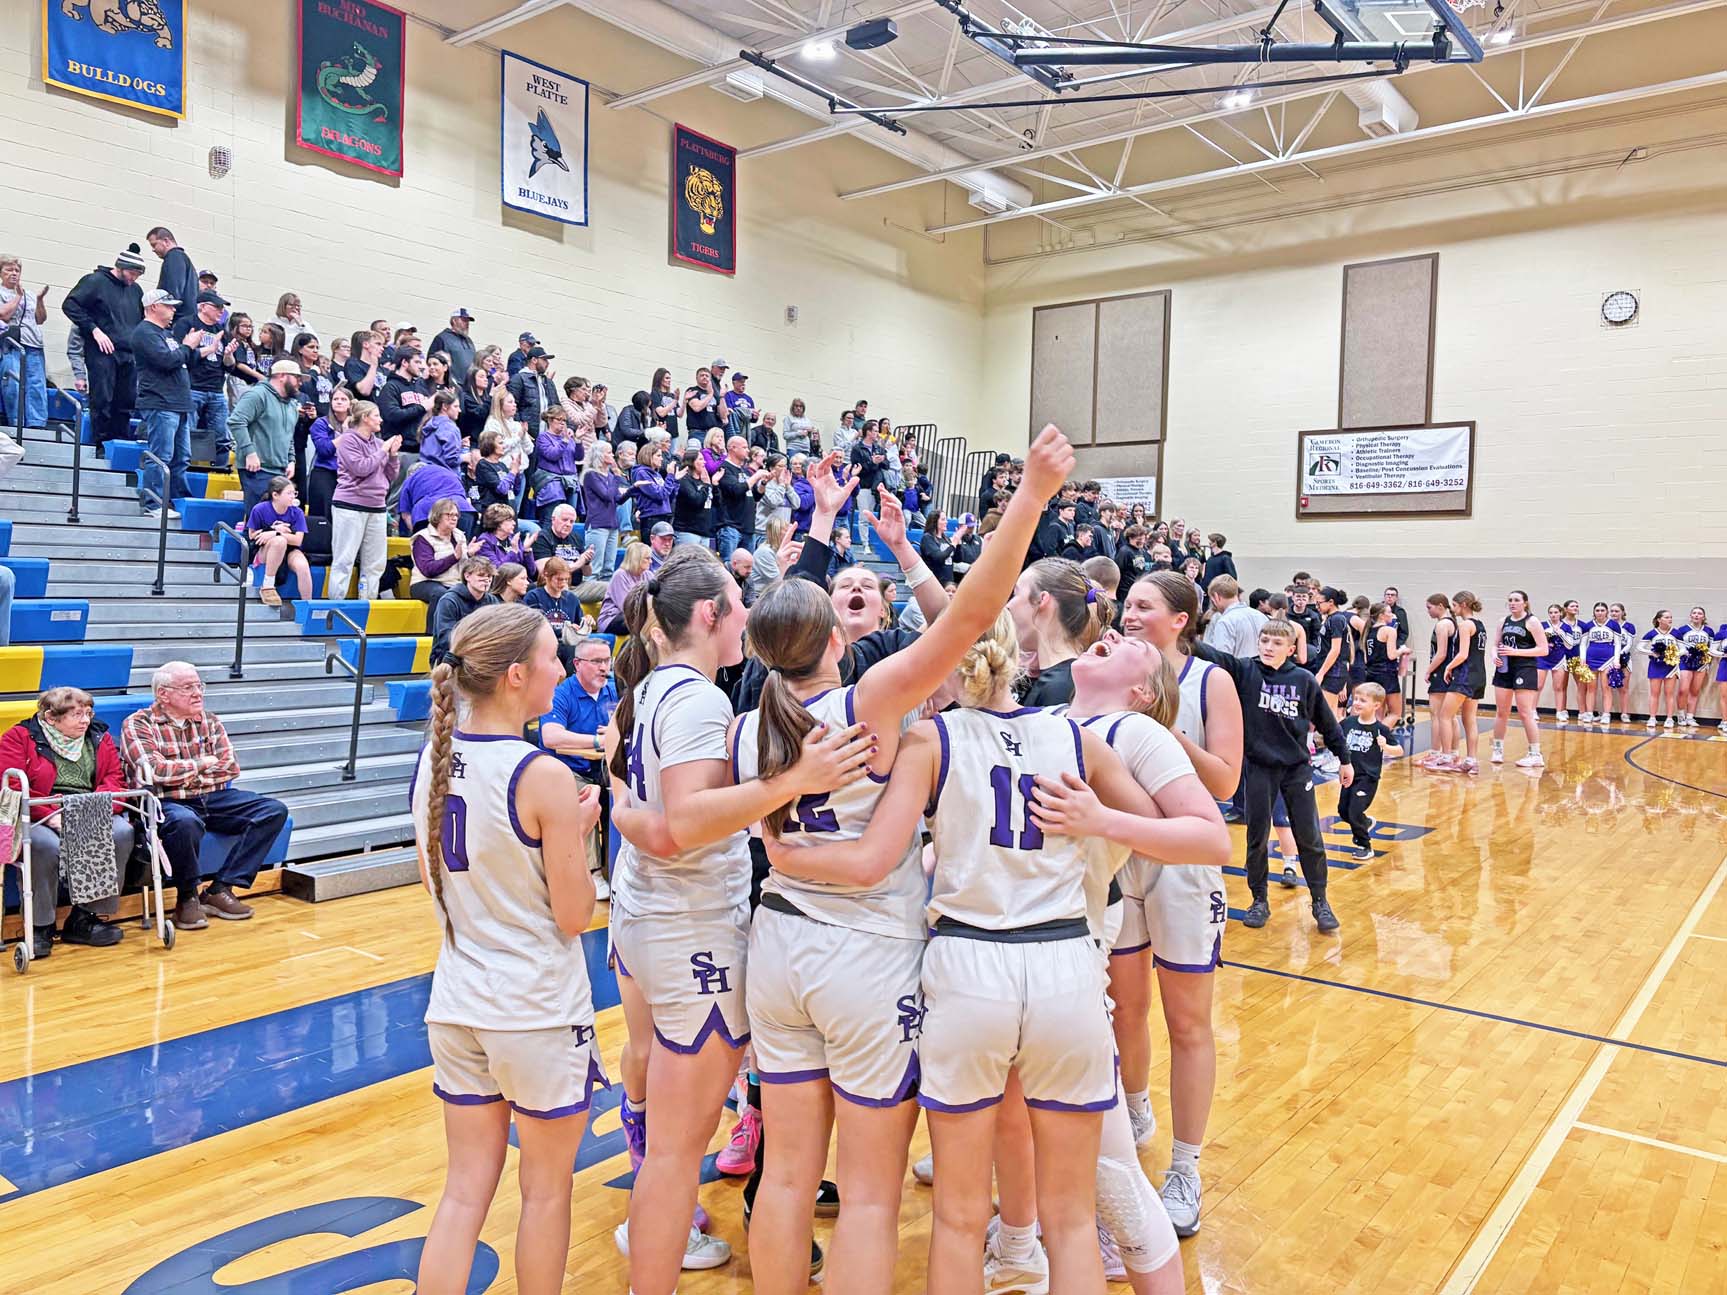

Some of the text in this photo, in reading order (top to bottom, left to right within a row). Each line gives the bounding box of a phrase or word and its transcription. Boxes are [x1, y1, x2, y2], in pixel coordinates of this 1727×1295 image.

[318, 2, 389, 38] BUCHANAN
[67, 59, 166, 96] BULLDOGS
[532, 74, 560, 92] WEST
[526, 82, 568, 105] PLATTE
[321, 127, 382, 156] DRAGONS
[518, 187, 569, 209] BLUEJAYS
[691, 241, 720, 258] TIGERS
[1258, 691, 1299, 717] DOGS
[989, 764, 1044, 851] 11
[690, 951, 732, 995] SH
